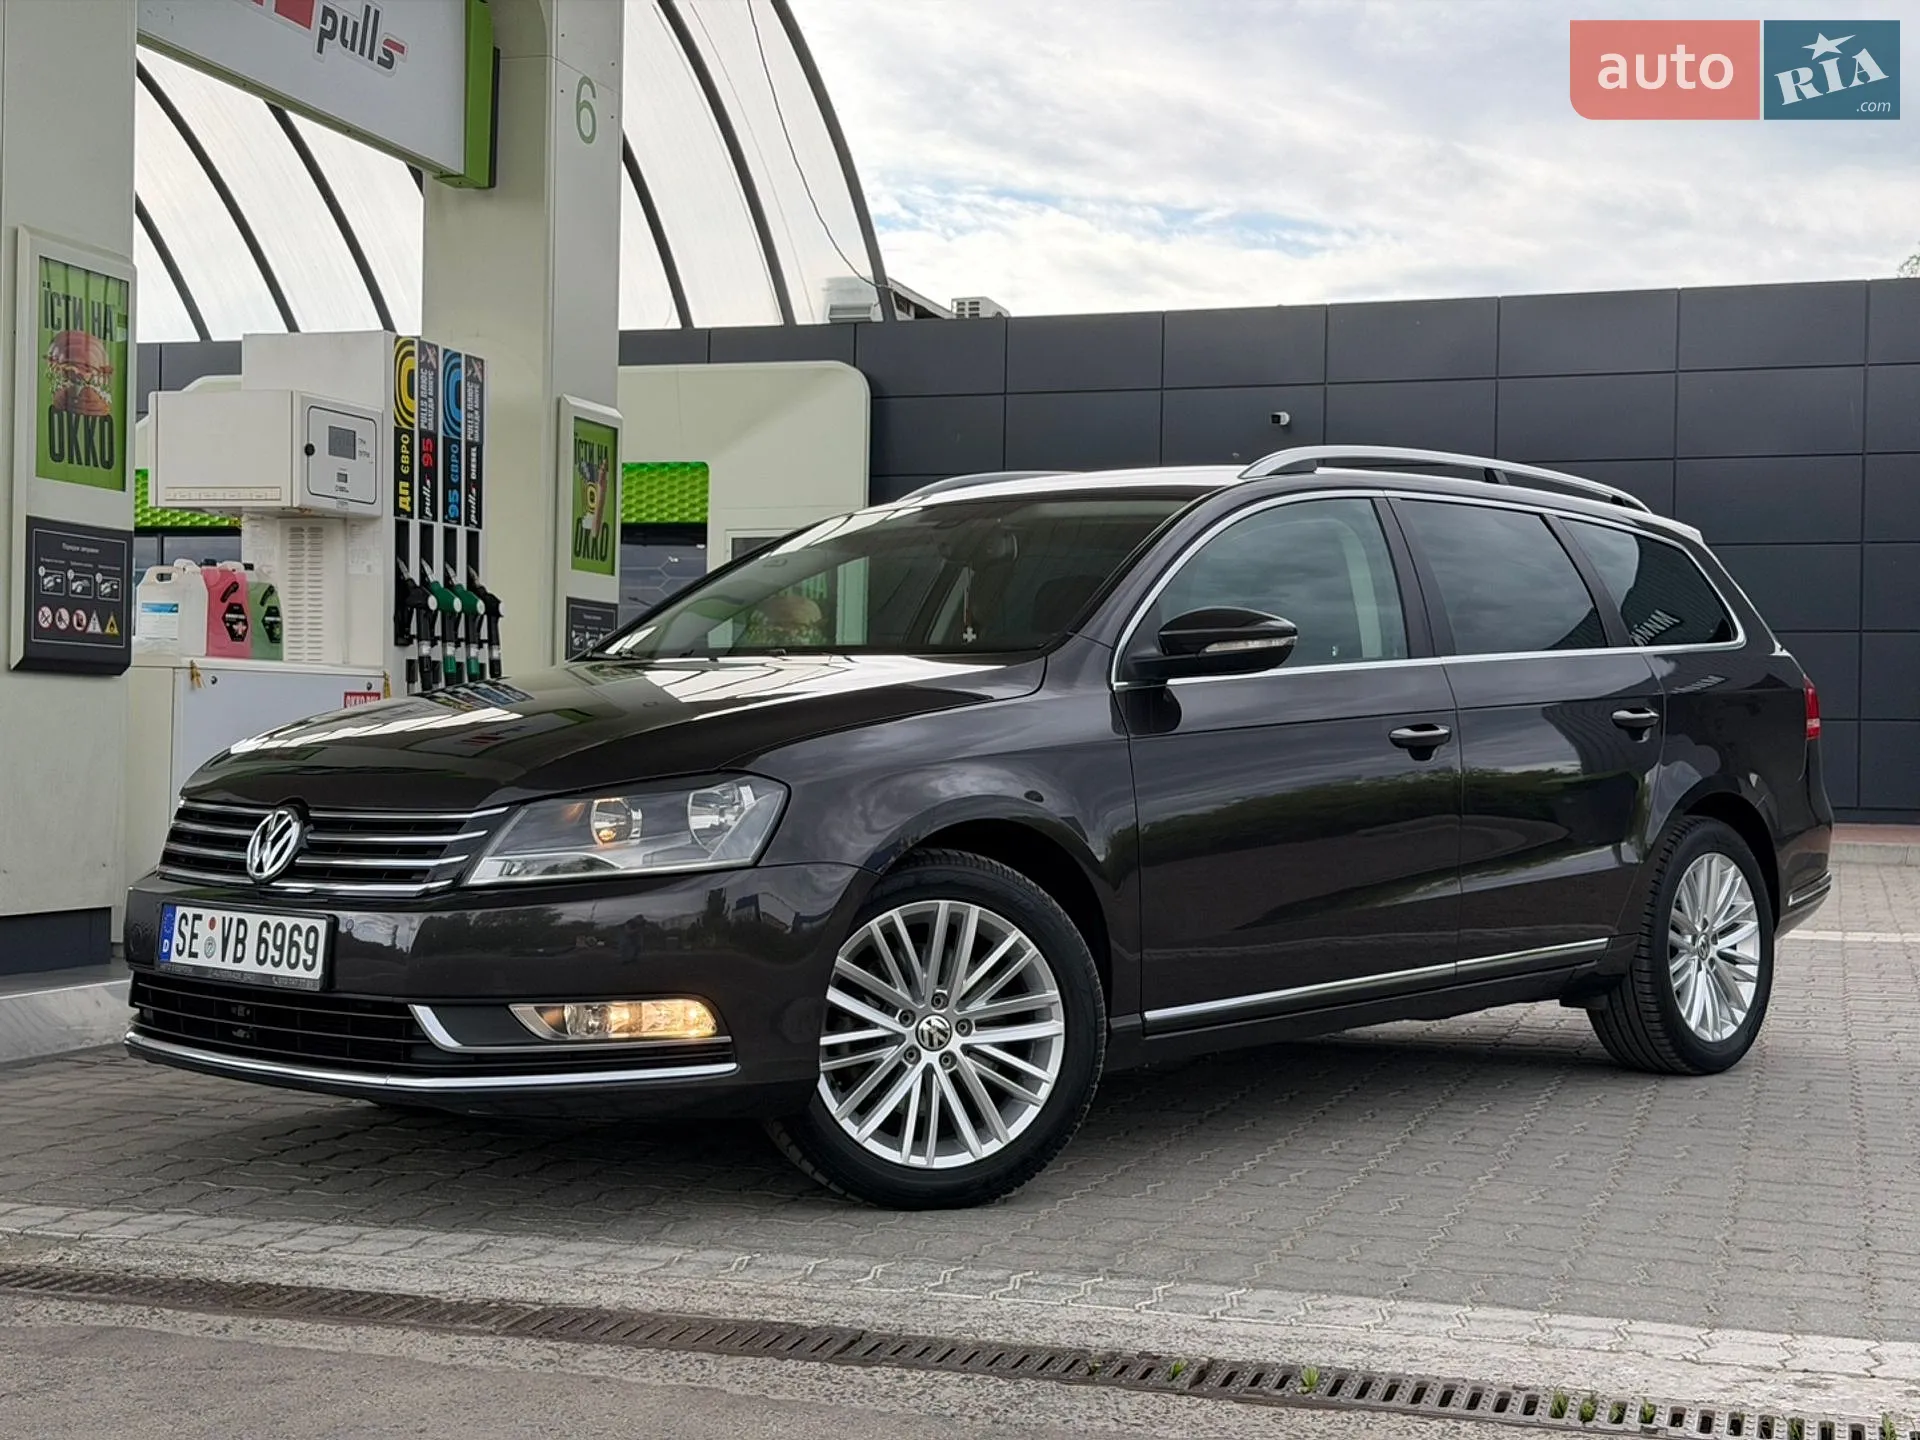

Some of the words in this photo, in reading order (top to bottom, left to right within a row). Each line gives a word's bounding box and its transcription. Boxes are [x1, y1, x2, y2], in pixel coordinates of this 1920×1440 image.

[317, 4, 405, 71] pulls
[575, 75, 597, 145] 6
[42, 281, 83, 332] ЇСТИ
[91, 299, 114, 342] НА
[49, 404, 114, 470] ОККО
[400, 433, 411, 474] ЄВРО
[422, 437, 433, 469] 95
[450, 443, 460, 483] ЄВРО
[398, 480, 412, 513] ДП
[421, 472, 433, 518] pulls
[447, 488, 460, 520] 95
[162, 939, 170, 953] D
[175, 911, 204, 960] SE
[220, 915, 249, 964] VB
[255, 919, 320, 972] 6969
